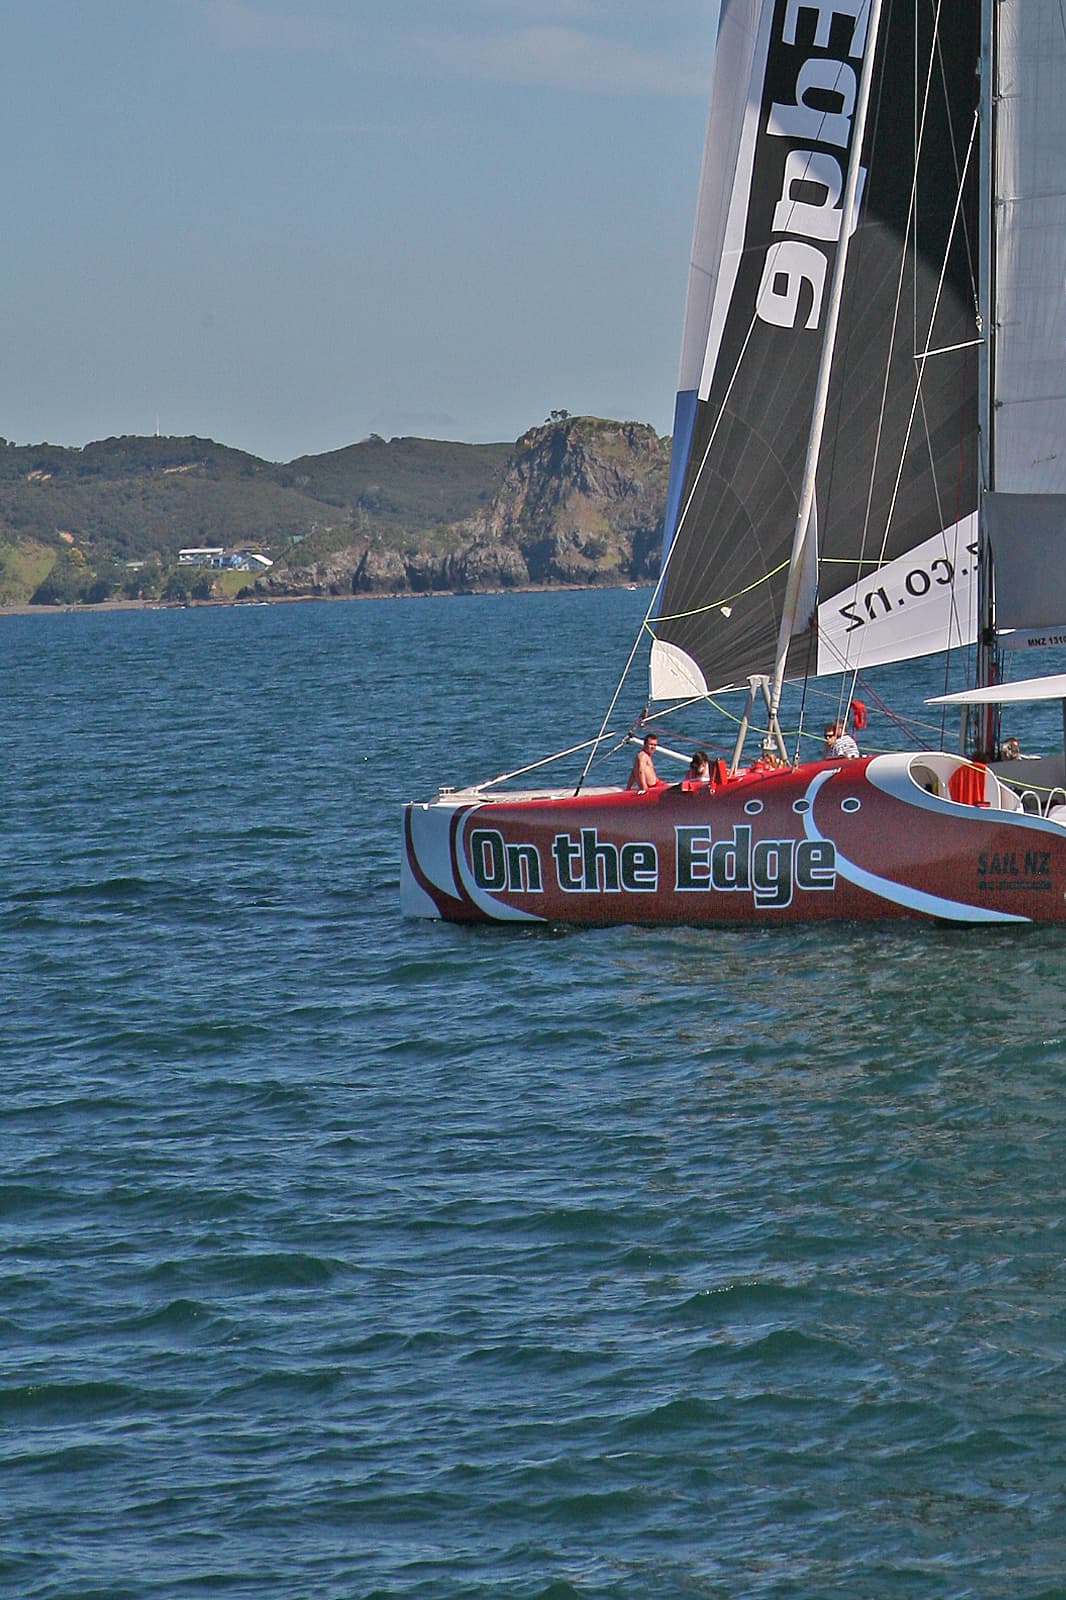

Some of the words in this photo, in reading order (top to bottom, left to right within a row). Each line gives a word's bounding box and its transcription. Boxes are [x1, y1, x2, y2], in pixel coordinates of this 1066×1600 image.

[1027, 637, 1047, 647] MNZ
[470, 829, 544, 892] On
[552, 828, 658, 893] the
[674, 824, 837, 909] Edge
[978, 850, 1019, 875] SAIL
[1024, 850, 1051, 874] NZ
